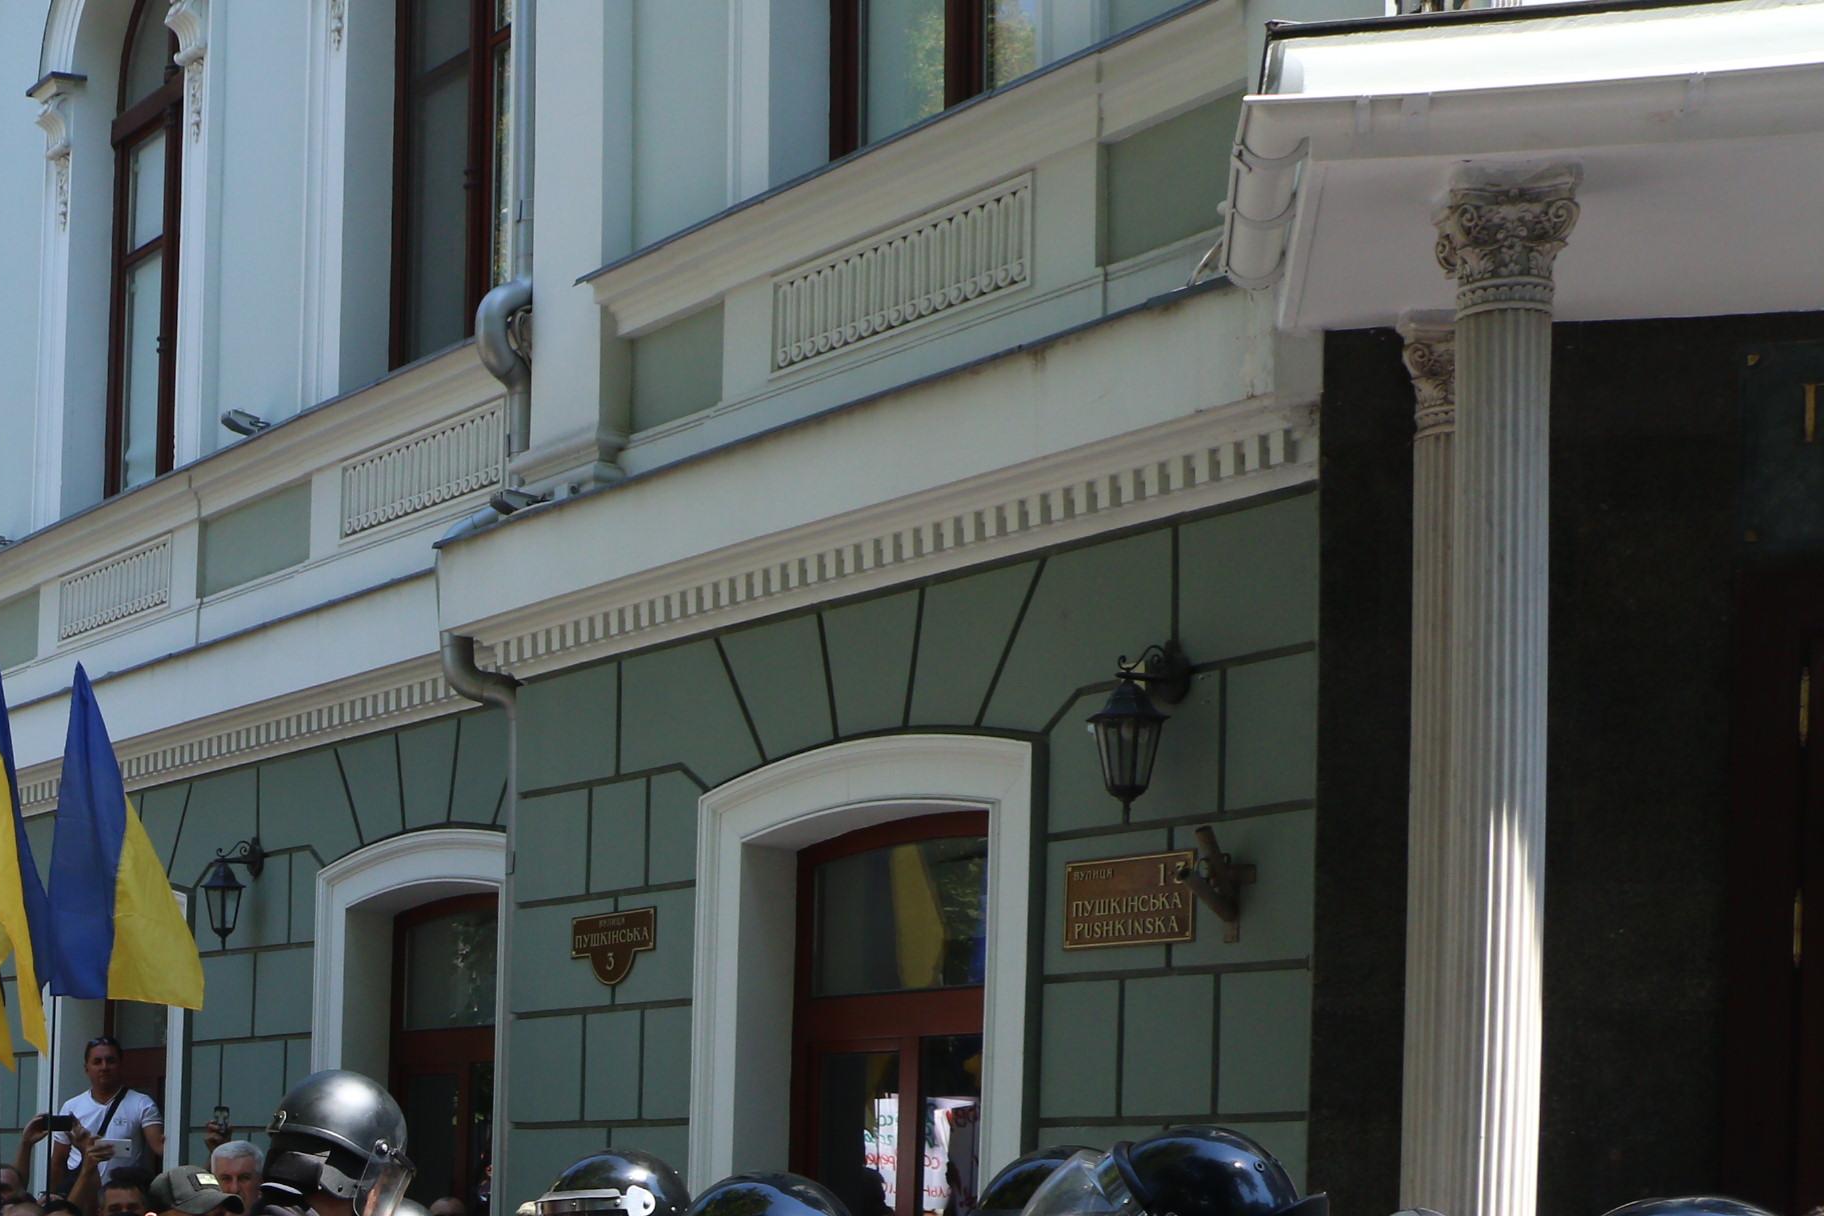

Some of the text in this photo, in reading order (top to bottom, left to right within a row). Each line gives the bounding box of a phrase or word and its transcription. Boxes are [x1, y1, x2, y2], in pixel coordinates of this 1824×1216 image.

[1071, 891, 1183, 917] ПУШКІНСЬКА
[575, 926, 650, 949] ПУШКІНСЬКА
[1074, 915, 1180, 940] PUSHKINSKA
[605, 951, 616, 970] 3
